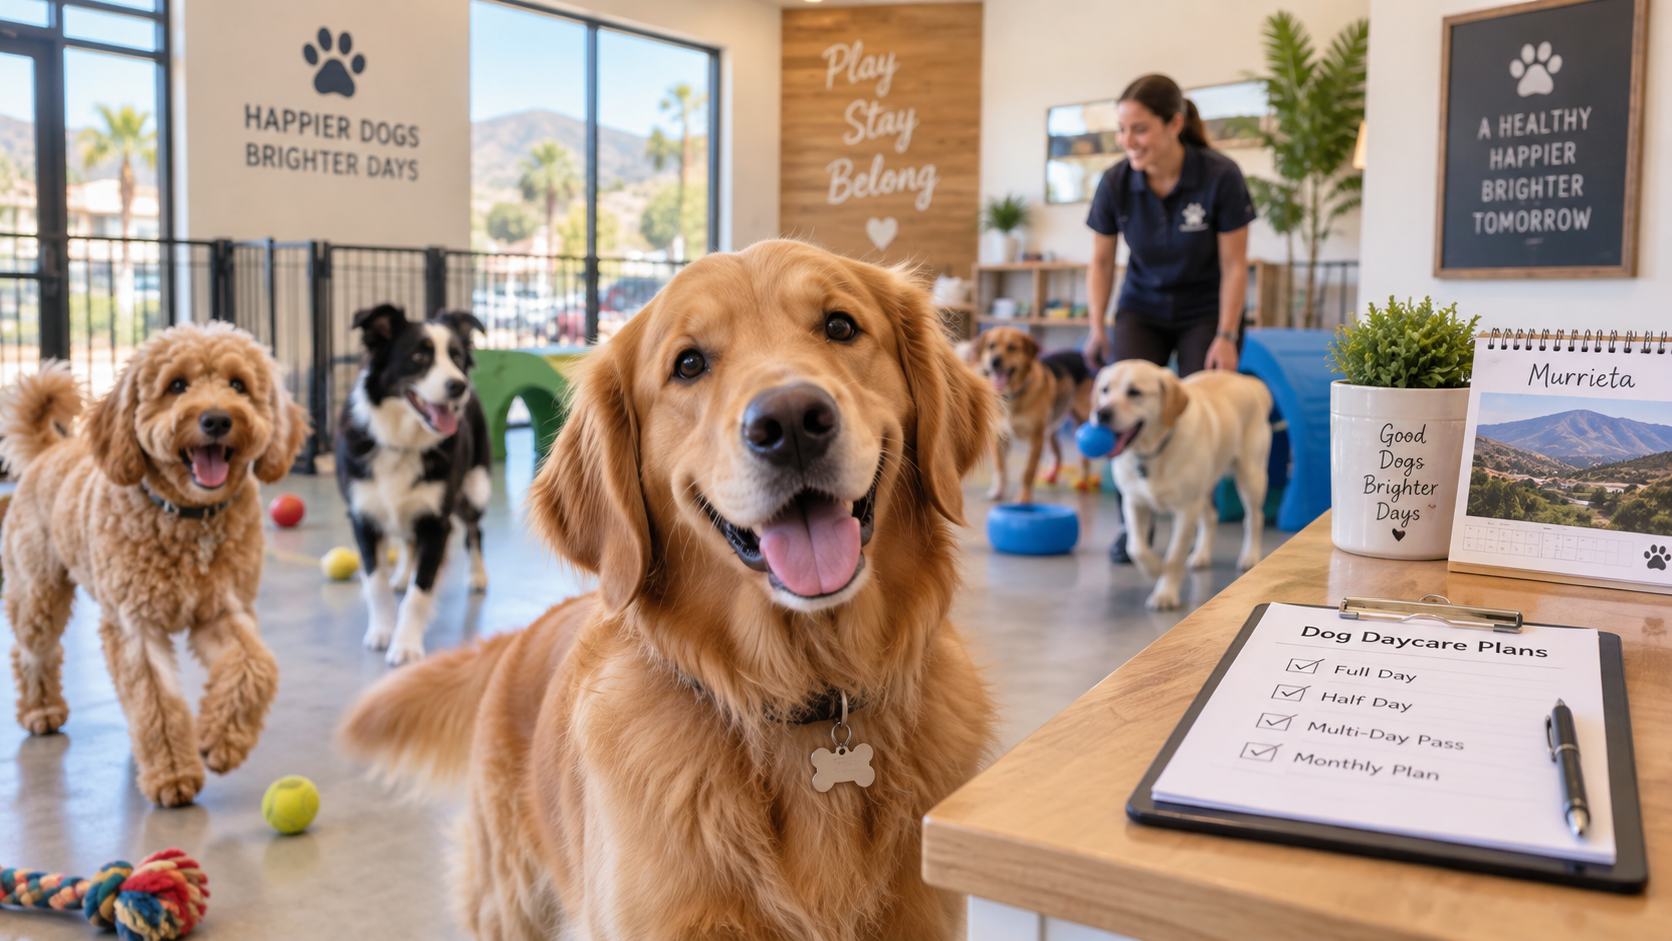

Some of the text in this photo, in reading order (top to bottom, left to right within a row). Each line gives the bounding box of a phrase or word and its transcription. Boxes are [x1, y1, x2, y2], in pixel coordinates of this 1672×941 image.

[821, 39, 900, 98] Play
[245, 103, 420, 148] HAPPIER DOGS
[842, 98, 920, 154] Stay
[1477, 106, 1592, 140] A HEALTHY
[246, 143, 419, 181] BRIGHTER DAYS
[1489, 141, 1576, 170] HAPPIER
[825, 152, 941, 212] Belong
[1481, 173, 1584, 202] BRIGHTER
[1472, 206, 1592, 235] TOMORROW
[1528, 363, 1635, 388] Murrieta
[1380, 423, 1426, 447] Good
[1379, 449, 1425, 477] Dogs
[1363, 474, 1438, 503] Brighter
[1376, 502, 1420, 528] Days
[1301, 625, 1548, 658] Dog Daycare Plans
[1334, 665, 1417, 684] Full Day
[1321, 692, 1413, 713] Half Day
[1307, 721, 1464, 751] Multi-Day Pass
[1293, 752, 1440, 781] Monthly Plan
